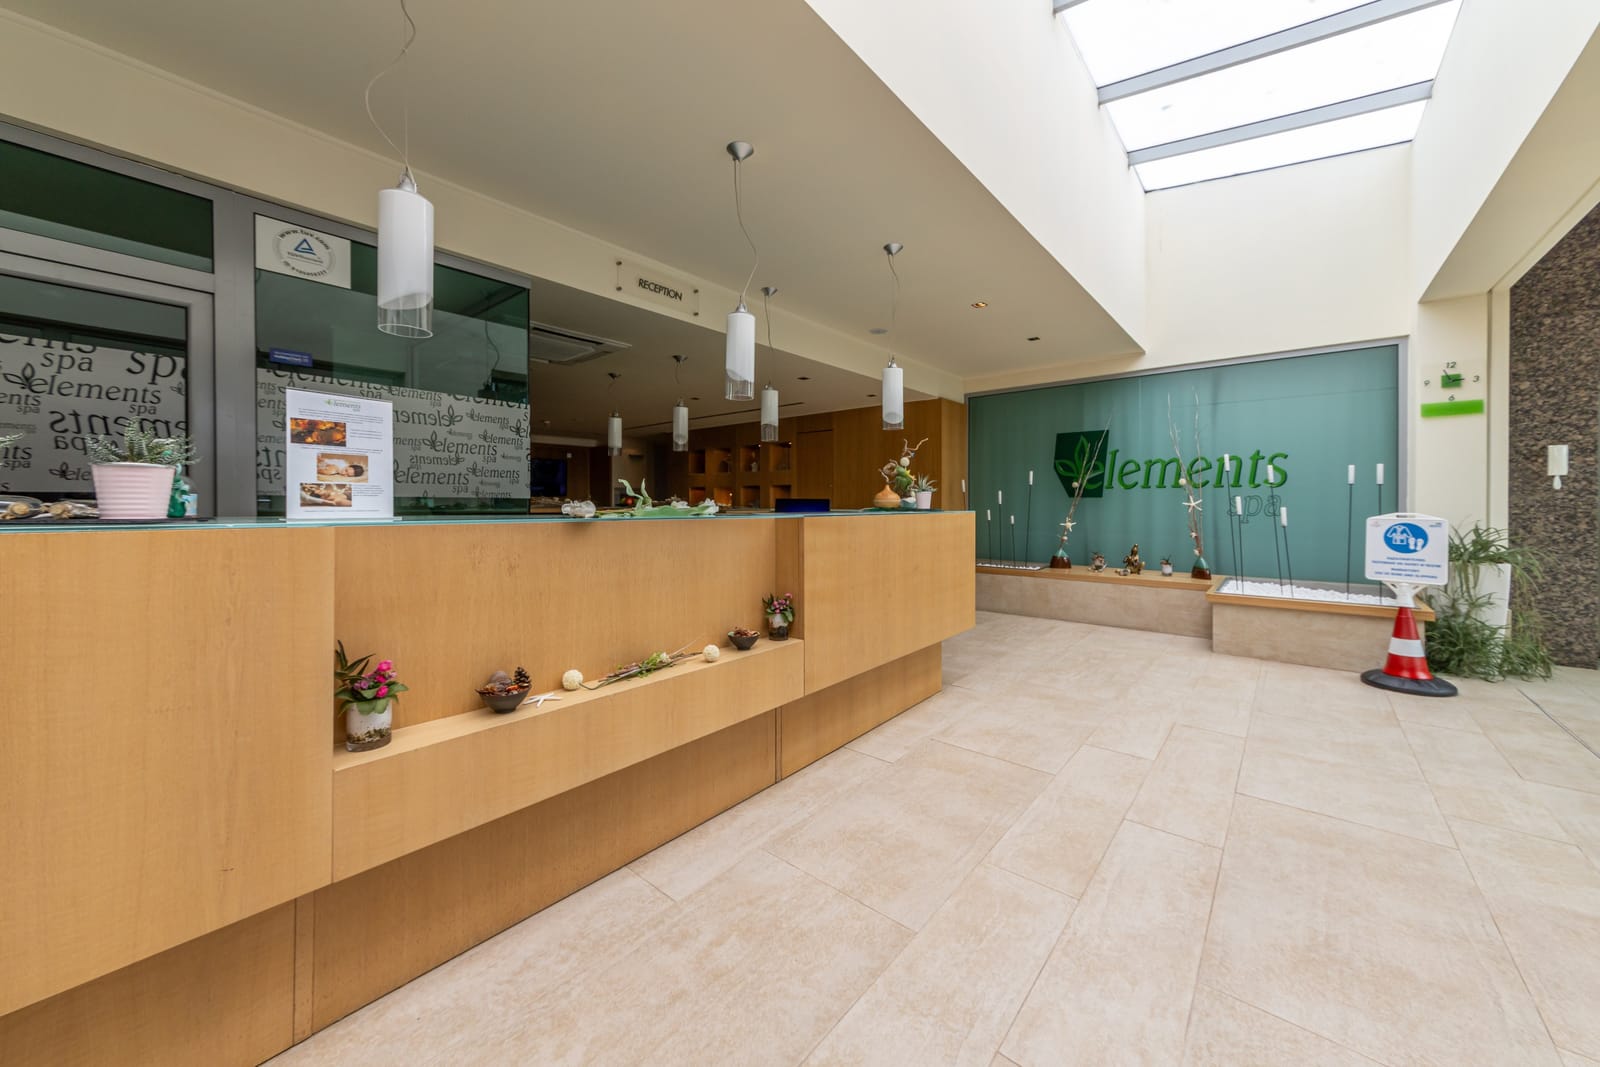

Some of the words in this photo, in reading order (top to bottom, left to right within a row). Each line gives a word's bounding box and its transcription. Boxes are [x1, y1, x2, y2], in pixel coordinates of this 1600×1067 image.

[638, 278, 682, 301] RECEPTION
[41, 351, 93, 374] spa
[126, 351, 186, 385] sp
[1446, 361, 1457, 369] 12
[1473, 375, 1480, 383] 3
[28, 374, 161, 404] elements
[128, 403, 157, 417] spa
[433, 438, 497, 457] elements
[395, 467, 469, 486] elements
[474, 466, 520, 479] elements
